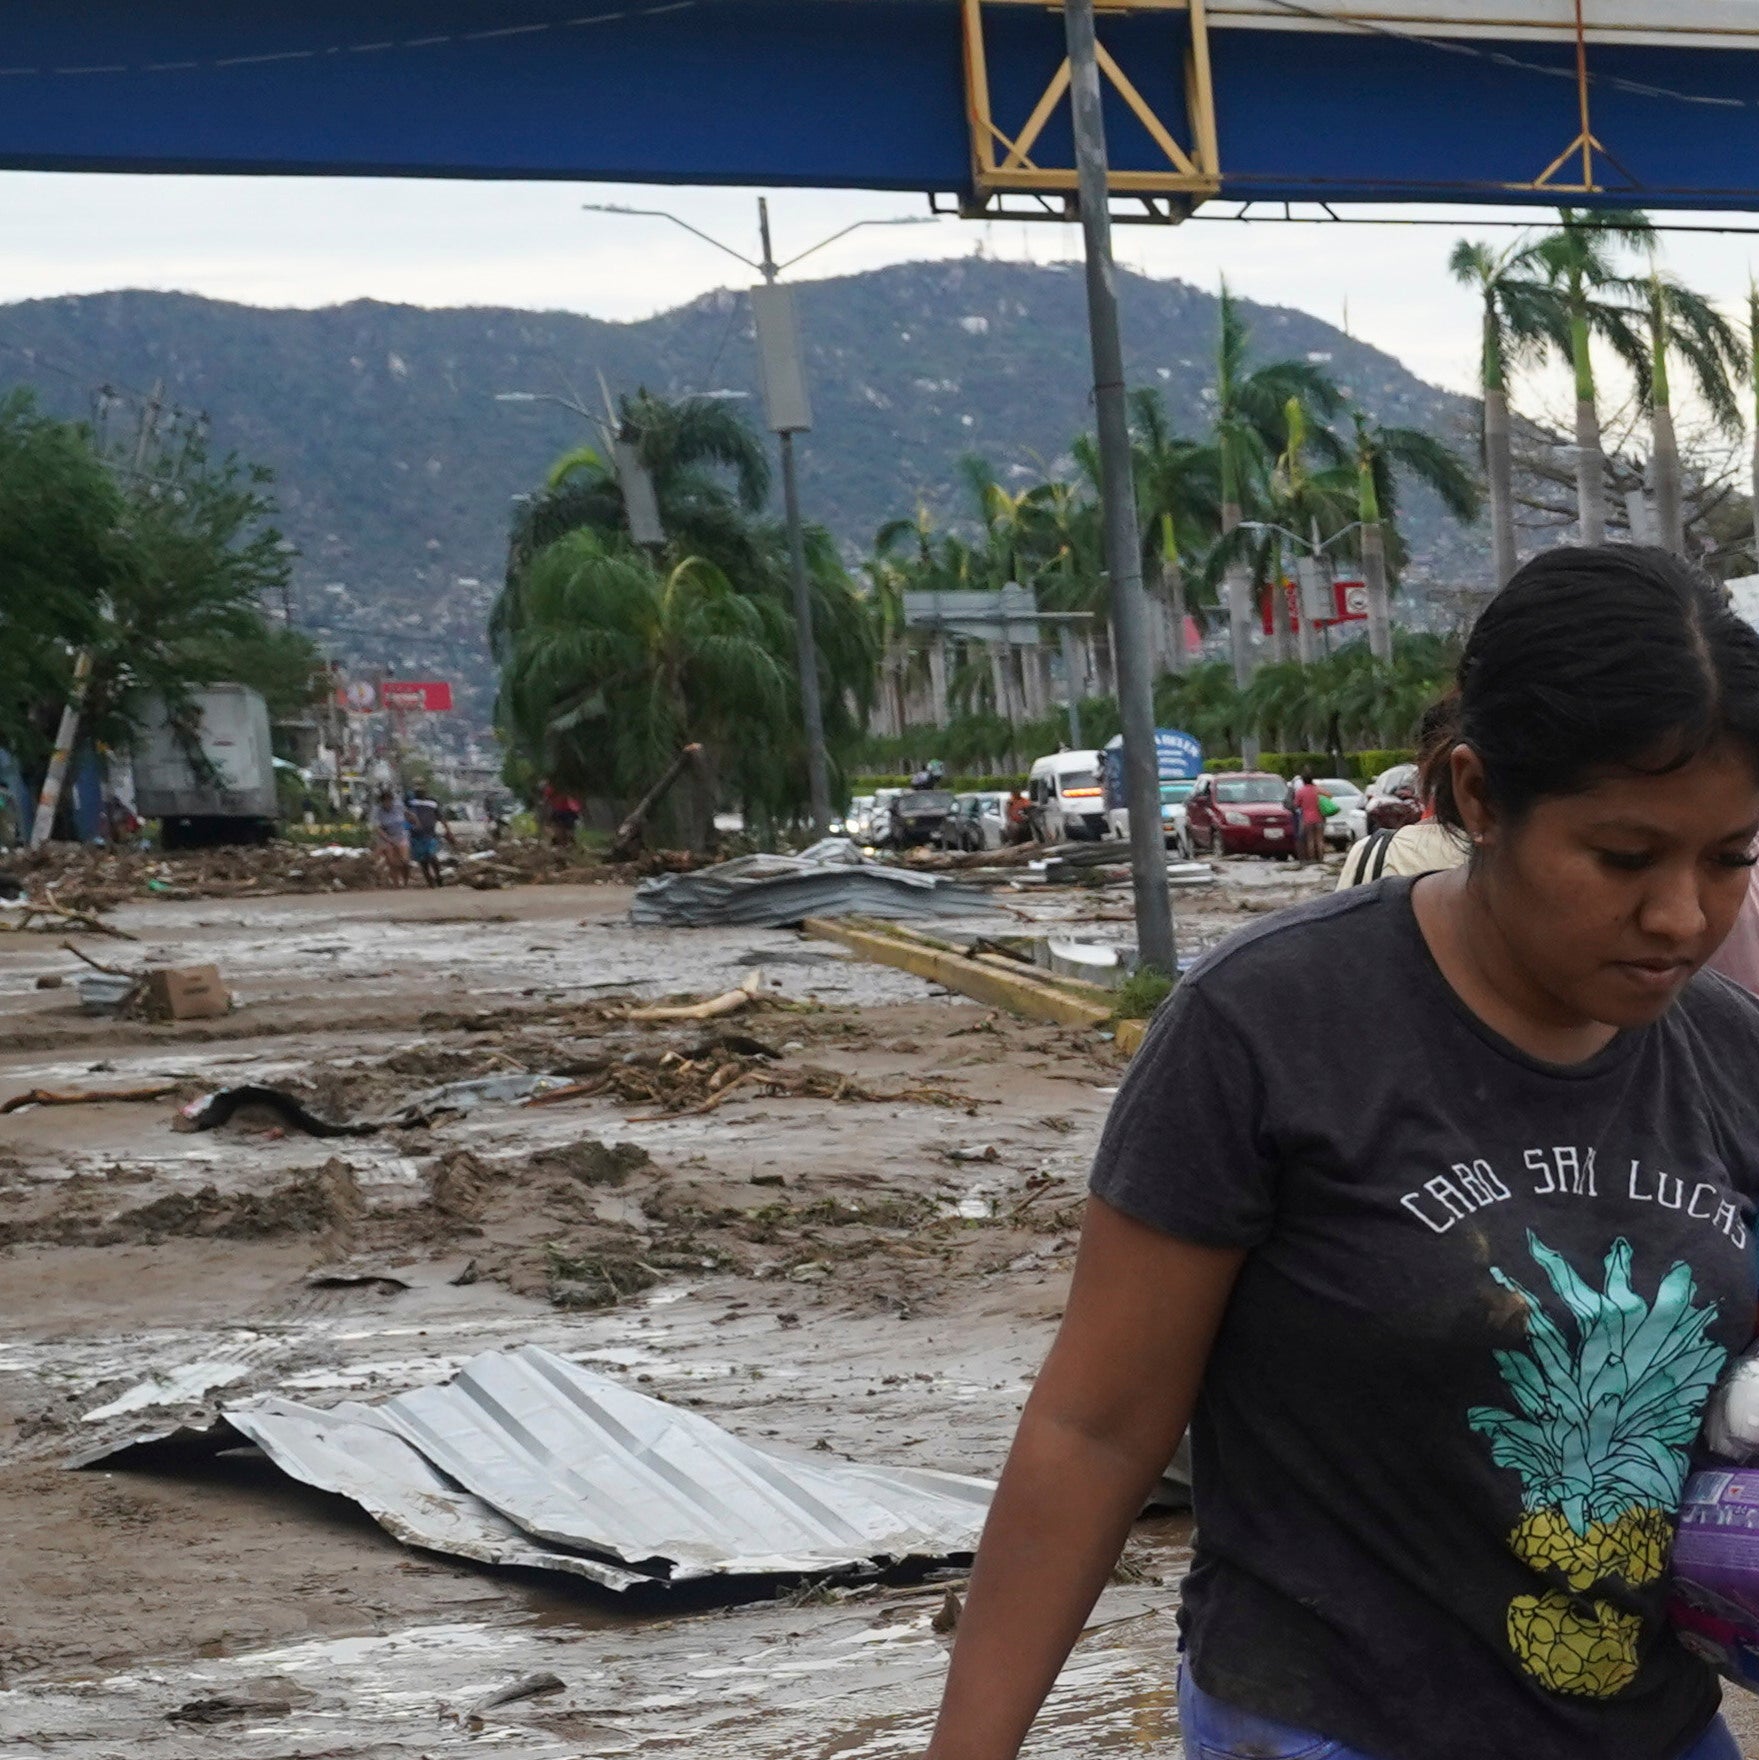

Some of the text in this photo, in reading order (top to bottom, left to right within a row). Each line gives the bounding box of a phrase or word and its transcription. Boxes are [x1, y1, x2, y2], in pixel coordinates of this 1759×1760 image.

[1400, 1159, 1512, 1233] CABO
[1523, 1146, 1598, 1197] SAN
[1629, 1159, 1747, 1250] LUCAS
